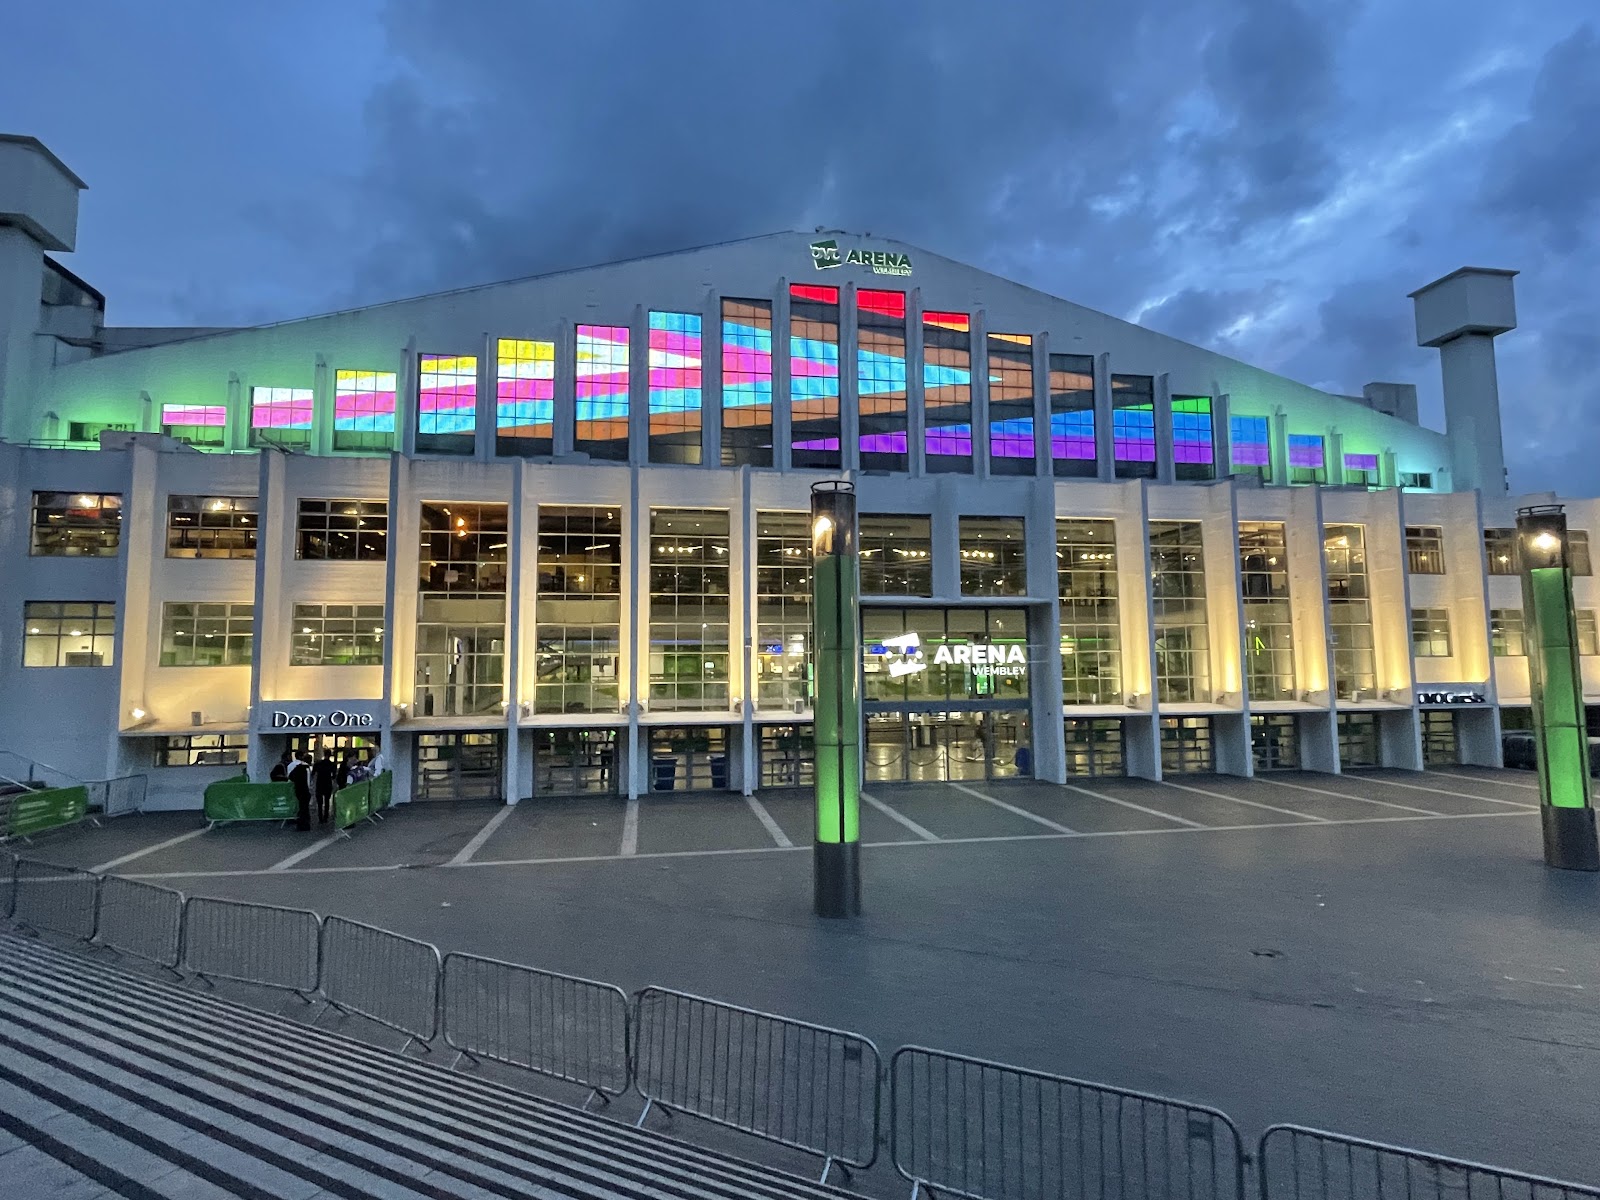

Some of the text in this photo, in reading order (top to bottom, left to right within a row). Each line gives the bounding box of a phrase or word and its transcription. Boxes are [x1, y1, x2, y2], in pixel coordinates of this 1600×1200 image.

[845, 249, 912, 269] ARENA
[933, 644, 1026, 664] ARENA
[972, 666, 1026, 676] WEMBLEY
[272, 709, 373, 728] Door One
